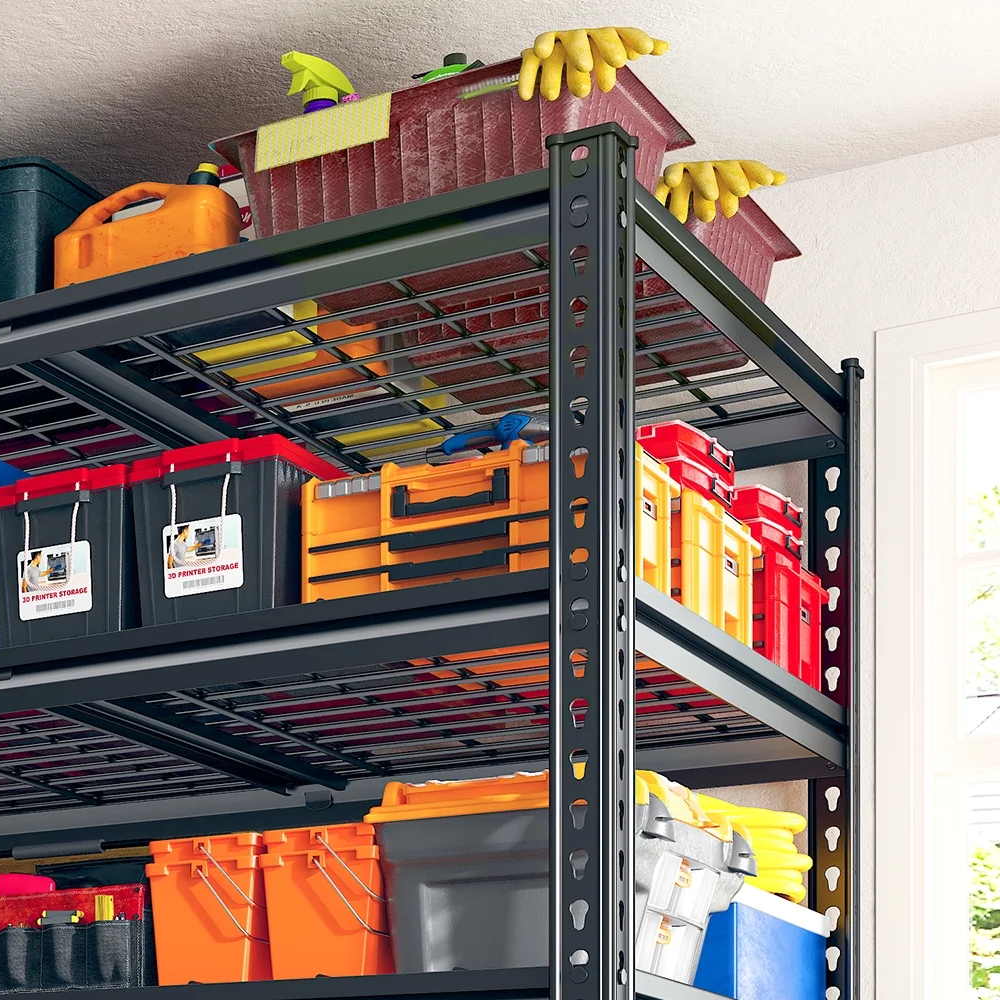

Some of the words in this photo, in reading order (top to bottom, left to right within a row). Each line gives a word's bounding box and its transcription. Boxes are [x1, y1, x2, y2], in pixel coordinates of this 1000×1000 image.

[178, 568, 206, 578] PRINTER
[208, 562, 239, 573] STORAGE
[32, 592, 58, 602] PRINTER
[59, 587, 88, 598] STORAGE
